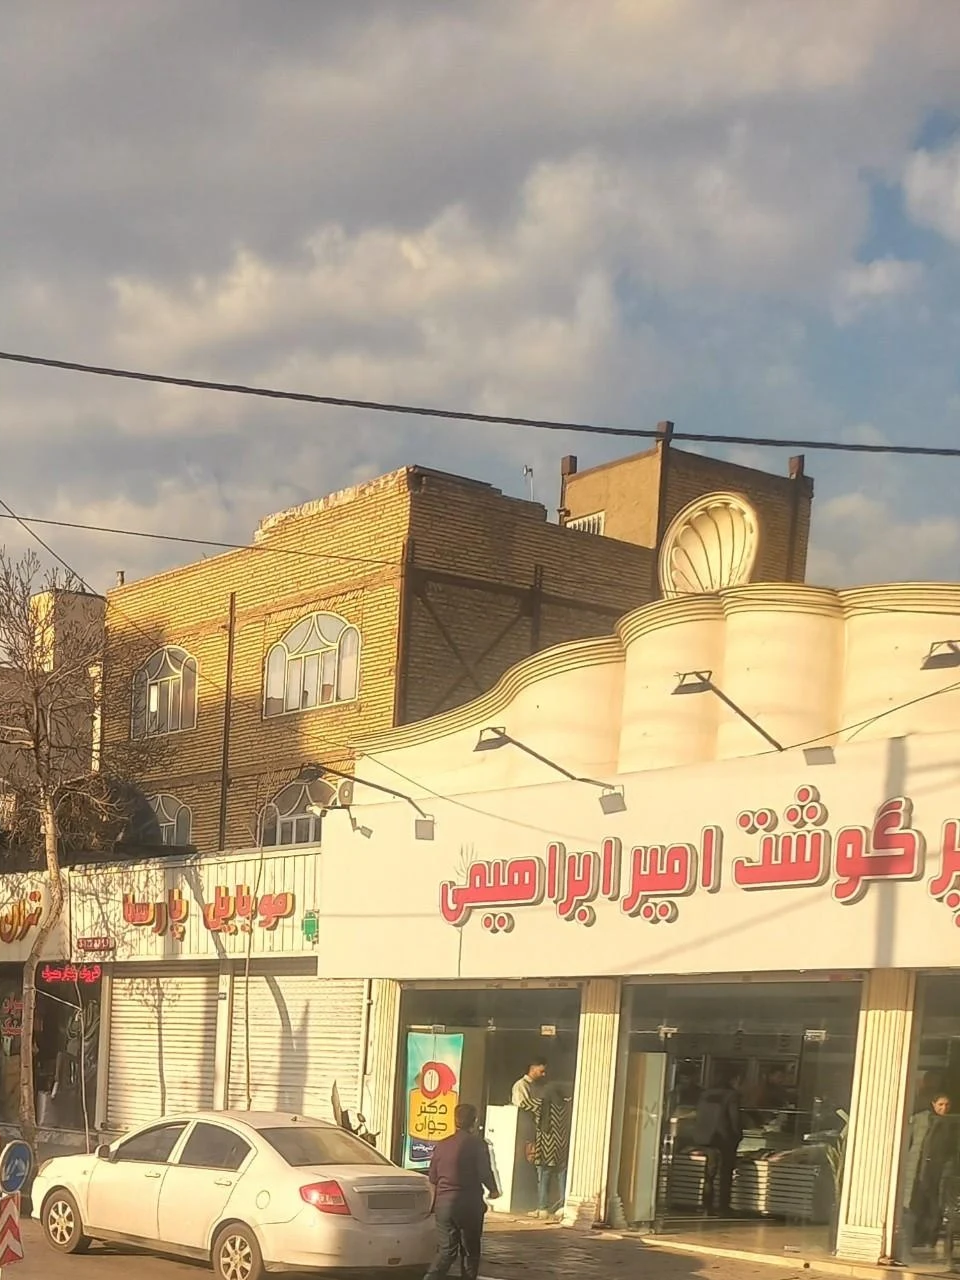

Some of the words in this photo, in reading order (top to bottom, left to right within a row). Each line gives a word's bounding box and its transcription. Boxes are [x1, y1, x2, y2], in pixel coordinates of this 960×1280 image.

[732, 785, 926, 905] گوشت
[440, 837, 621, 933] ابراهیمی
[620, 825, 724, 923] امیر
[122, 888, 189, 942] پارسا
[203, 884, 295, 934] موبایل
[414, 1116, 448, 1136] جوان
[416, 1100, 448, 1117] دکتر
